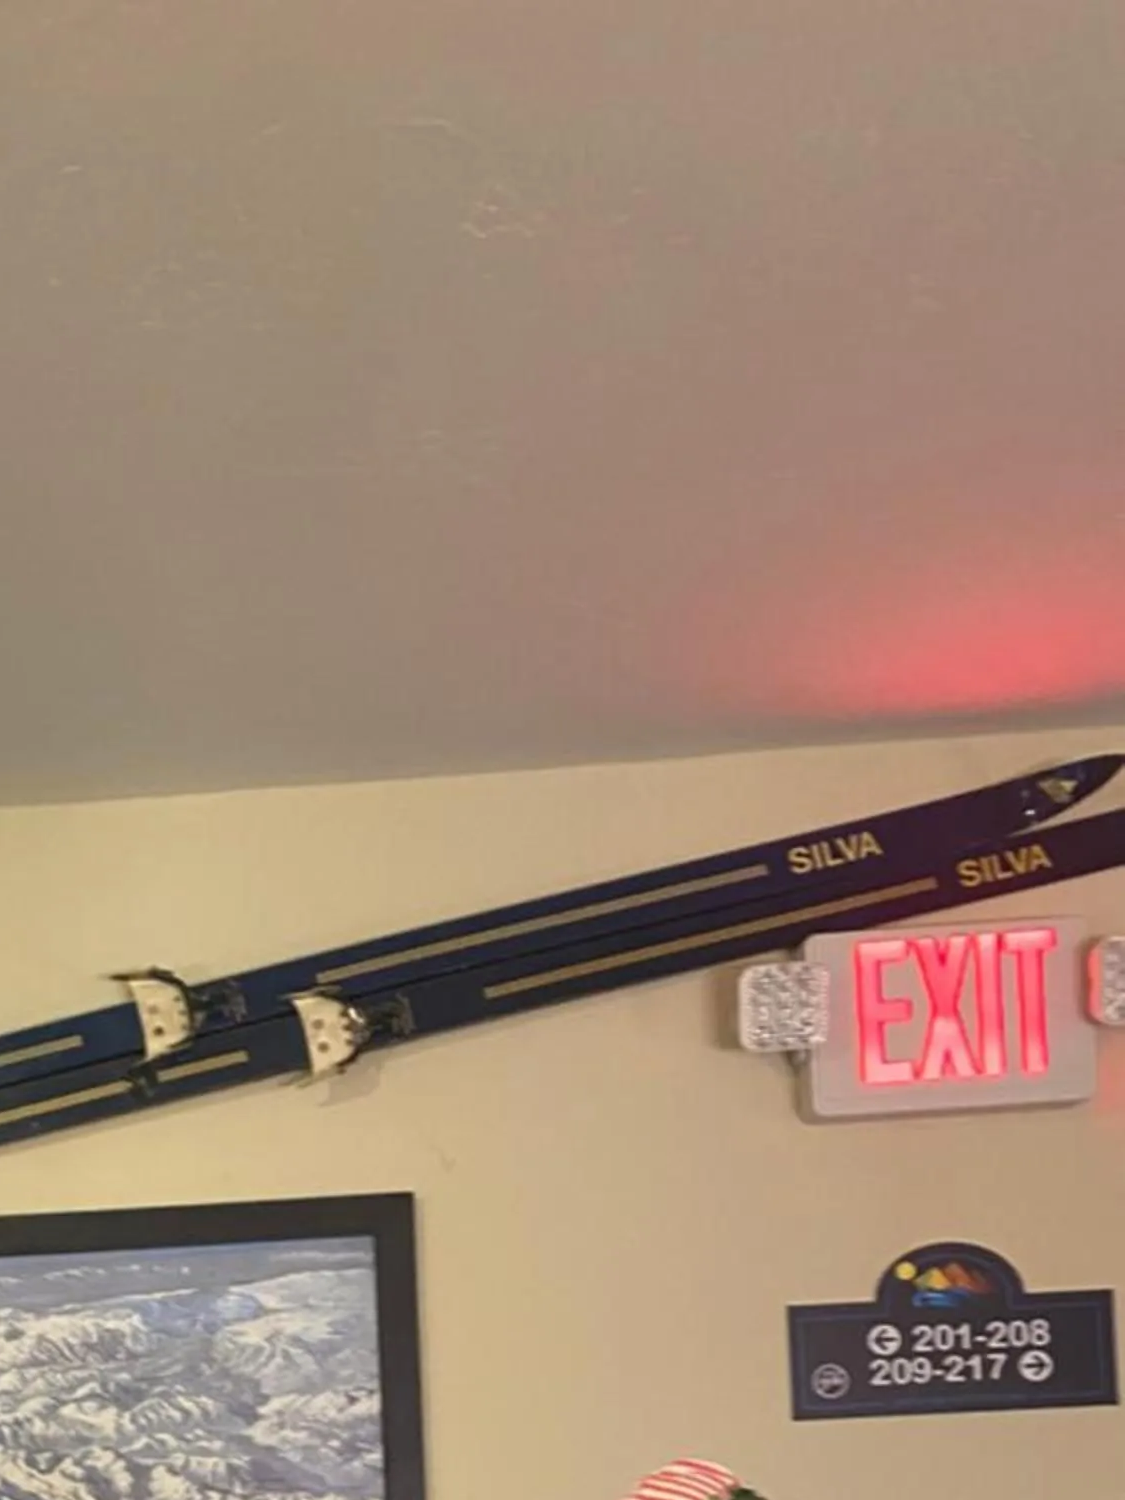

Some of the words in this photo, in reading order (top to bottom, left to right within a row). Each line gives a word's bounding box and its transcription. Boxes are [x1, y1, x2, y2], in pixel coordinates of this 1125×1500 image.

[787, 831, 884, 874] SILVA
[956, 844, 1053, 887] SILVA
[854, 928, 1058, 1085] EXIT
[911, 1319, 1051, 1352] 201-208
[868, 1352, 1009, 1386] 209-217
